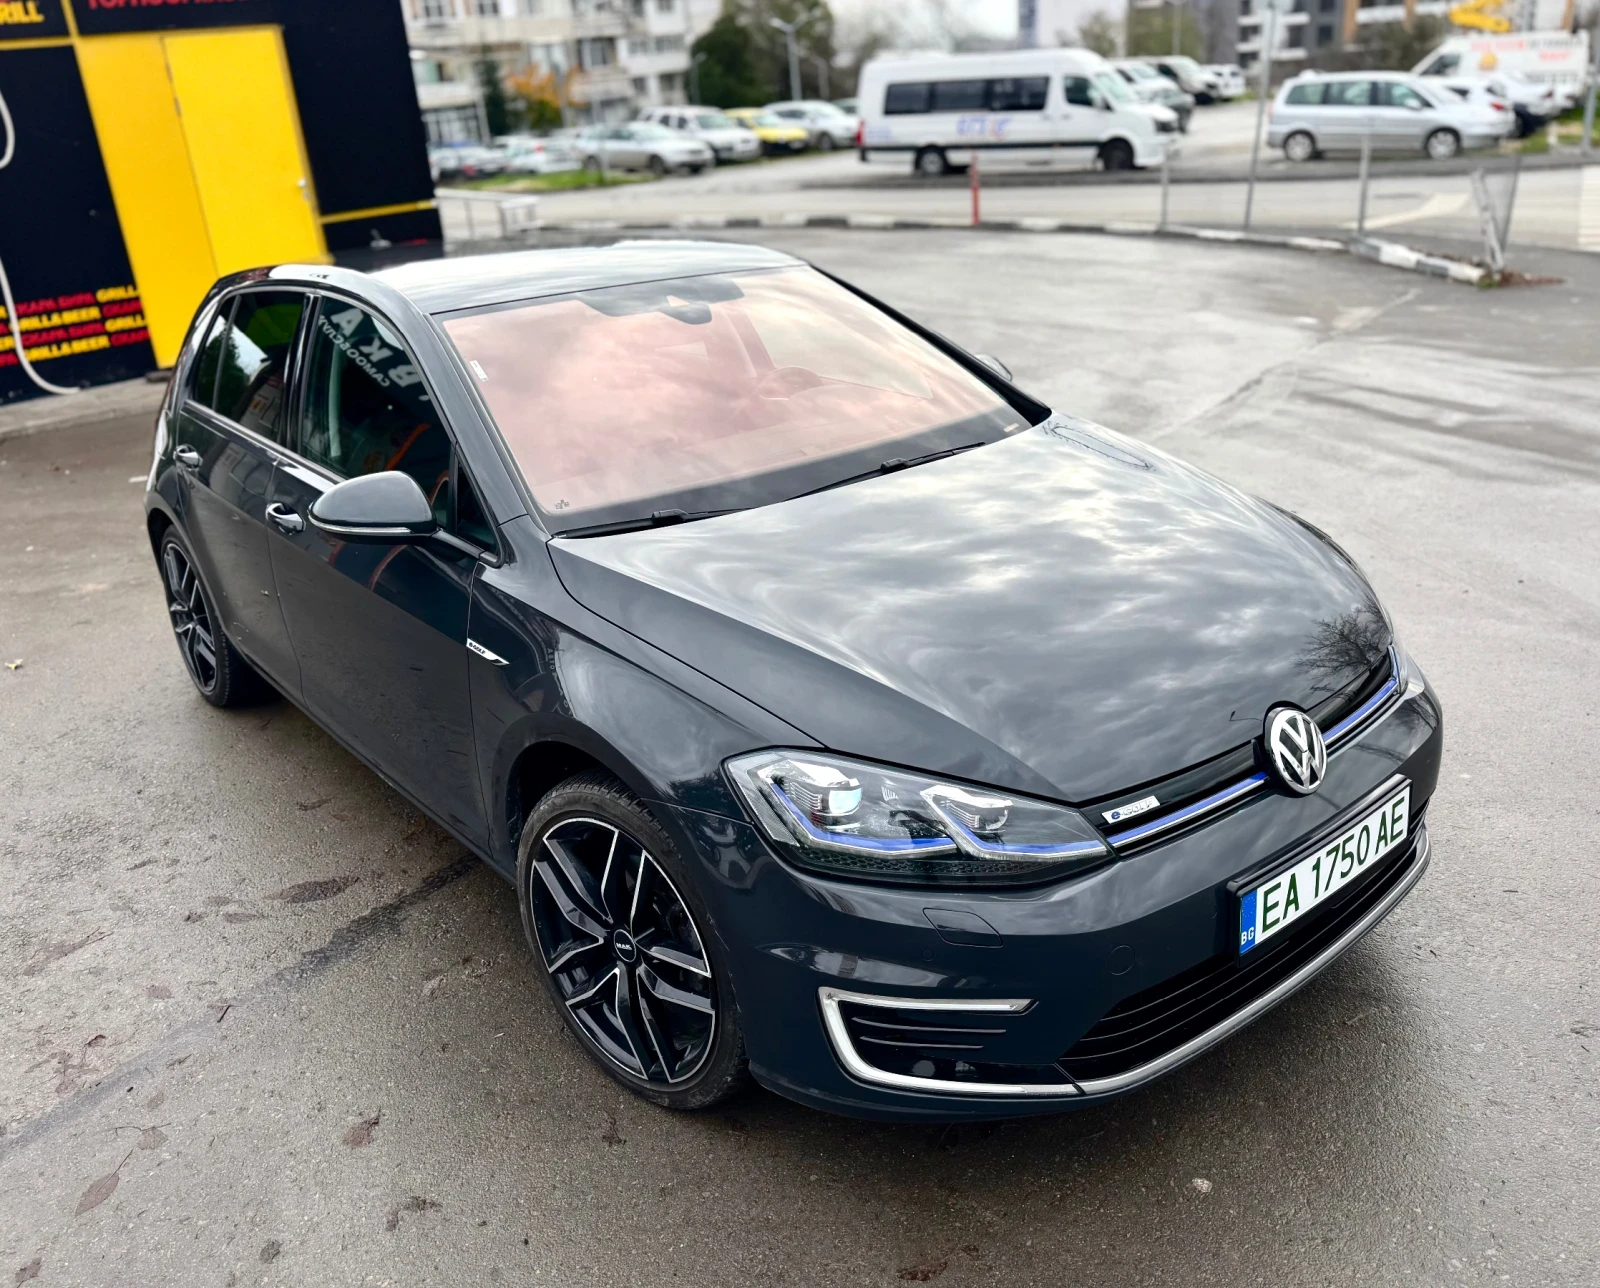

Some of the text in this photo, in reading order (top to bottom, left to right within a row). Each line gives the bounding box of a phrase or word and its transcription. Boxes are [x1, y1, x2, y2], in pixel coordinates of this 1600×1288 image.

[1262, 796, 1406, 933] EA 1750 AE
[1241, 926, 1255, 945] BG
